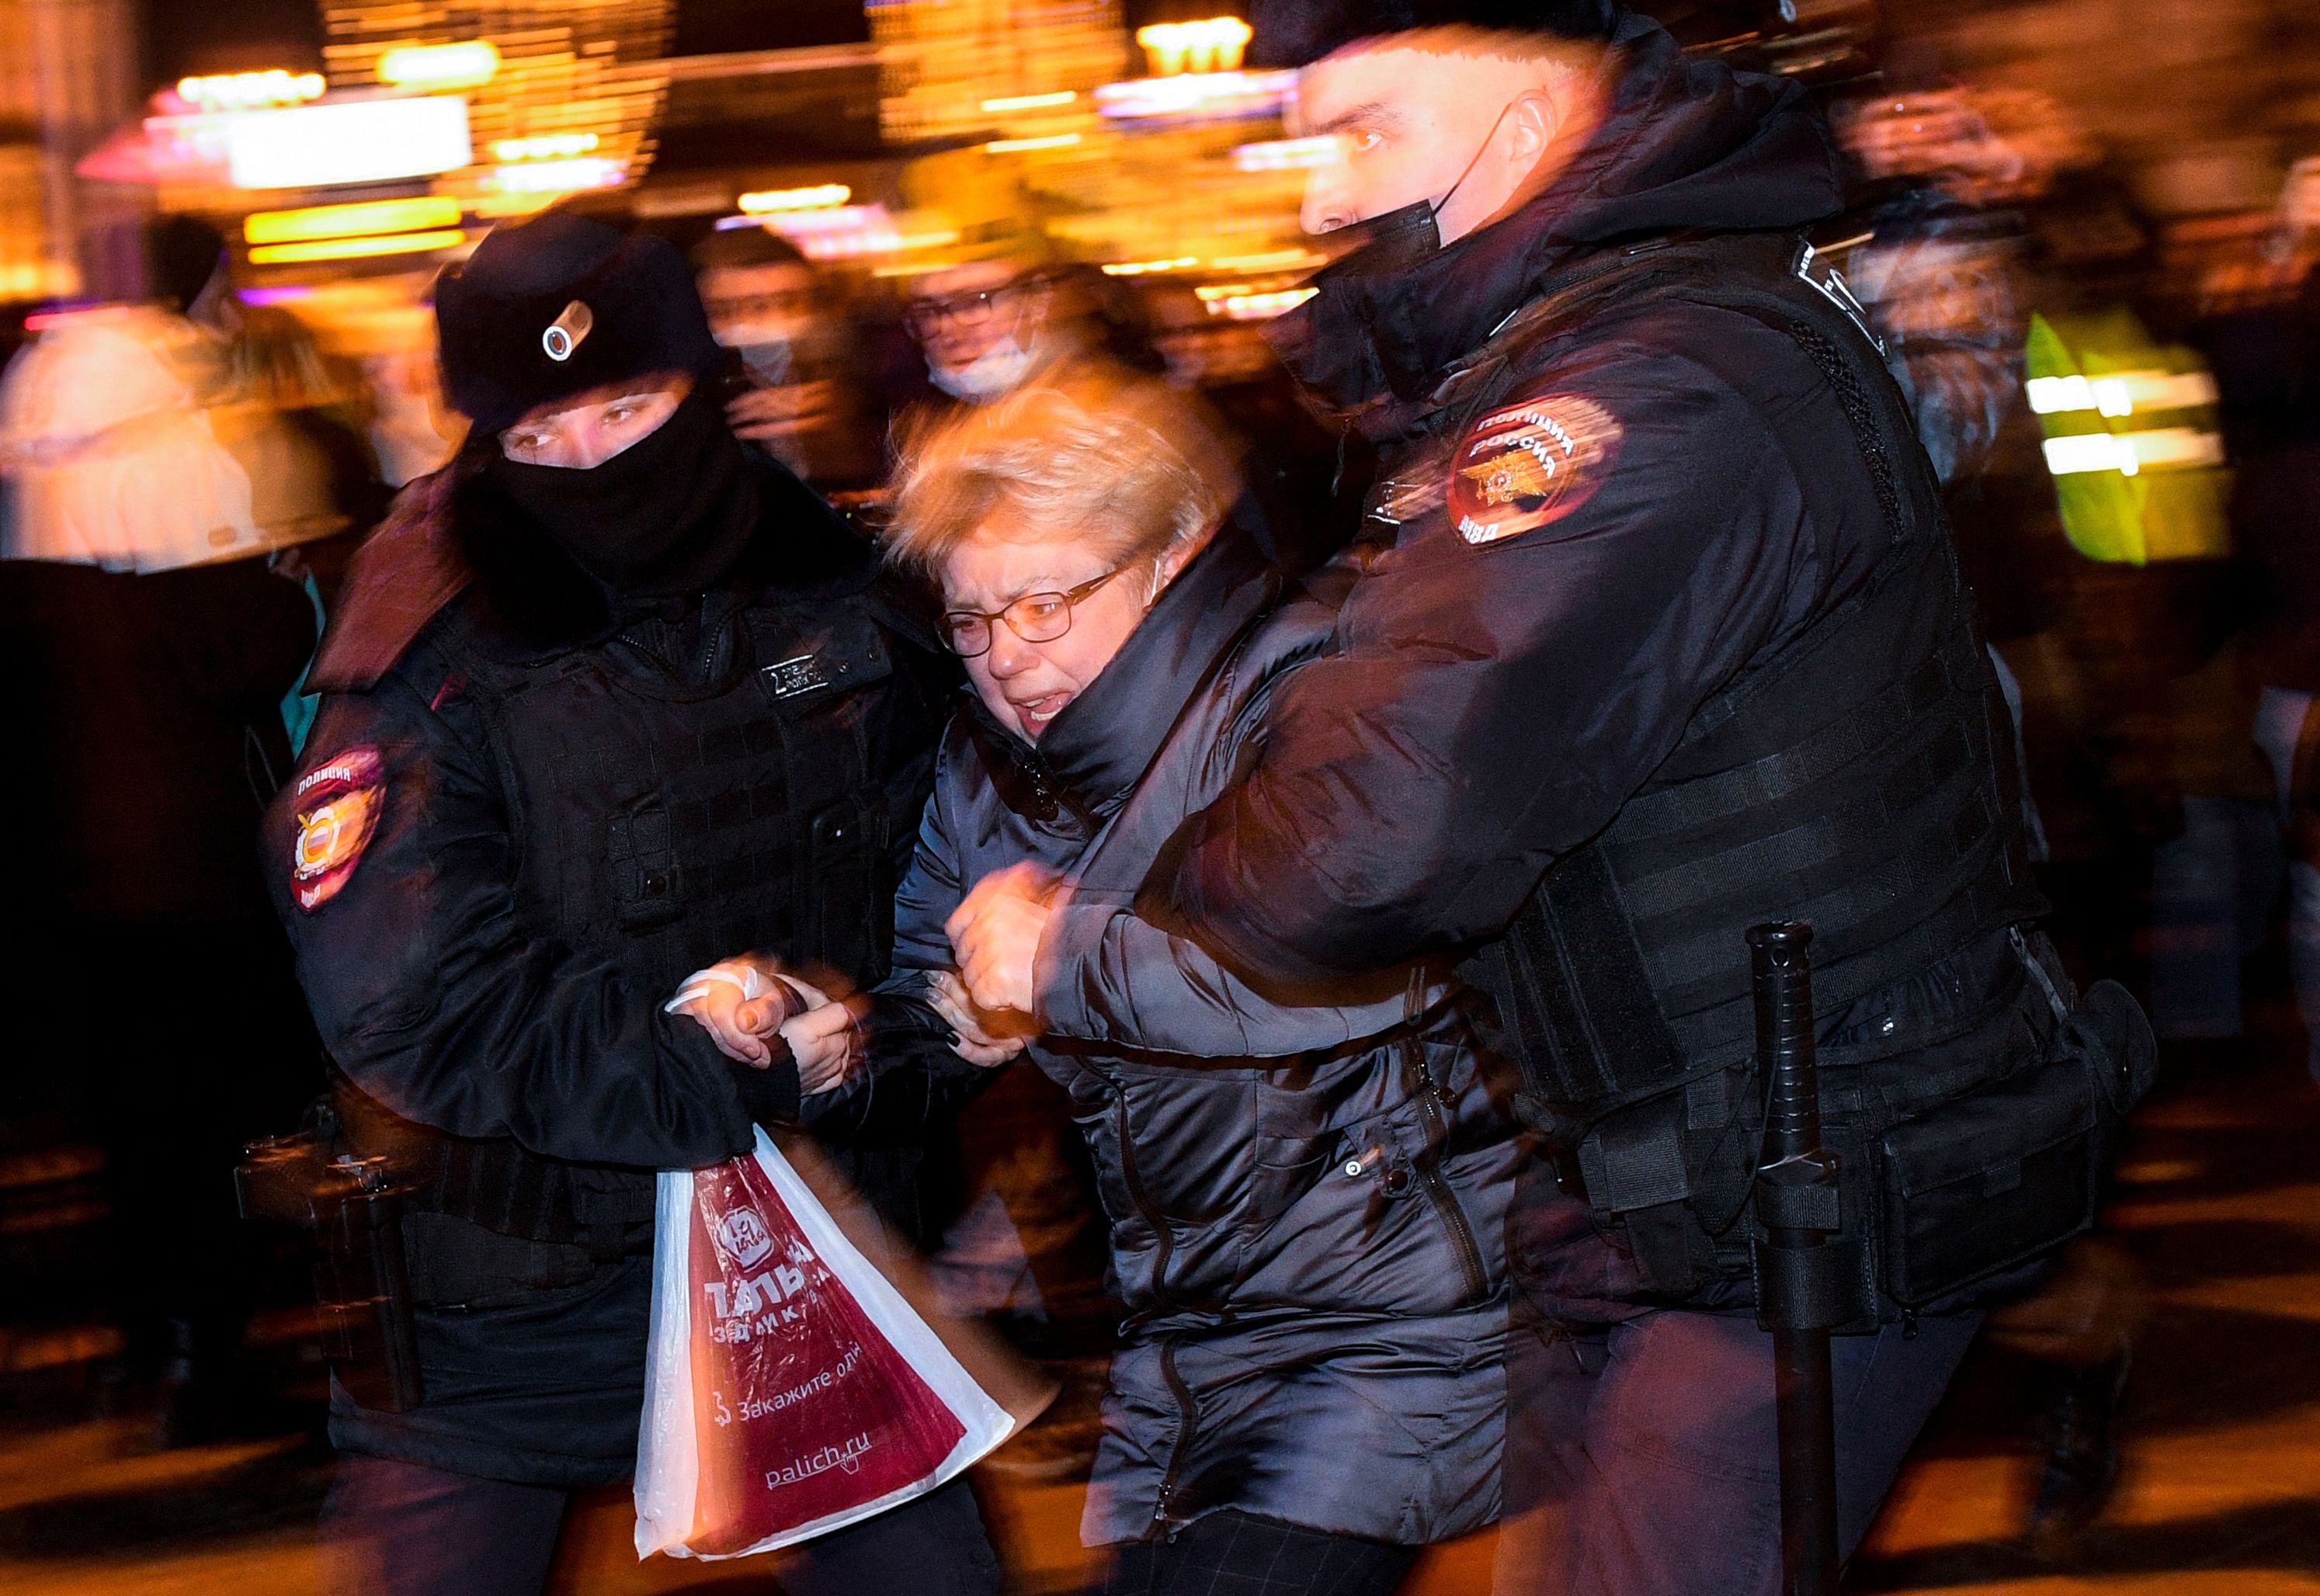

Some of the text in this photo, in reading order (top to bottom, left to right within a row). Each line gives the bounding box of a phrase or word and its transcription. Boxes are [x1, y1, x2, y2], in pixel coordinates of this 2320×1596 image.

[1469, 433, 1556, 479] РОССИЯ
[1458, 515, 1499, 544] МВД
[298, 766, 351, 796] ПОЛИЦИЯ
[738, 1371, 832, 1422] Закажите
[765, 1432, 872, 1490] palich.ru
